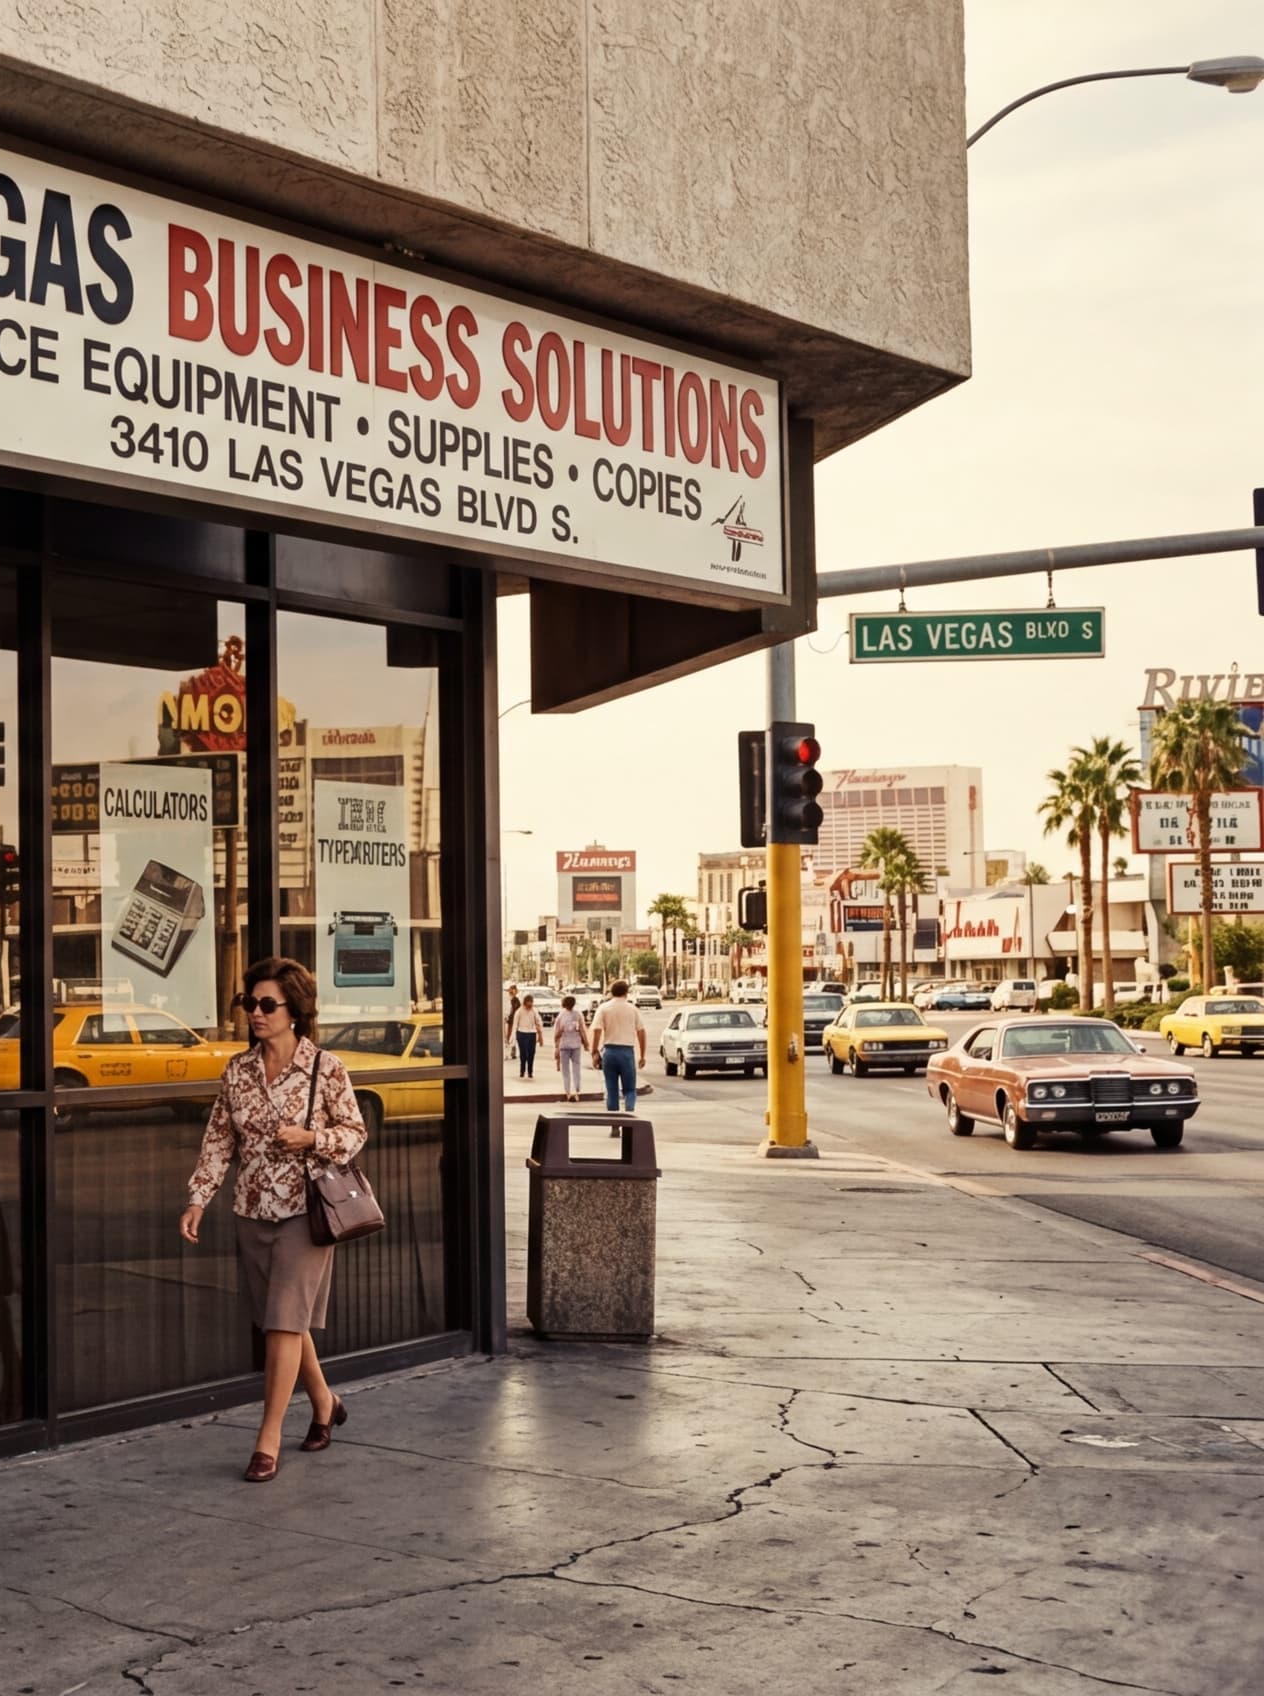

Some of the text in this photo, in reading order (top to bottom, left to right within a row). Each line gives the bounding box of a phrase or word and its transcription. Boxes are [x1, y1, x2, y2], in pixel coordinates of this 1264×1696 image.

[168, 223, 481, 409] BUSINESS
[501, 321, 767, 479] SOLUTIONS
[84, 338, 341, 442] EQUIPMENT
[388, 410, 554, 489] SUPPLIES
[593, 458, 702, 521] COPIES
[110, 415, 578, 544] 3410 LAS VEGAS BLVD S.
[862, 624, 913, 651] LAS
[926, 622, 1013, 650] VEGAS
[1081, 621, 1093, 639] S
[104, 787, 208, 822] CALCULATORS
